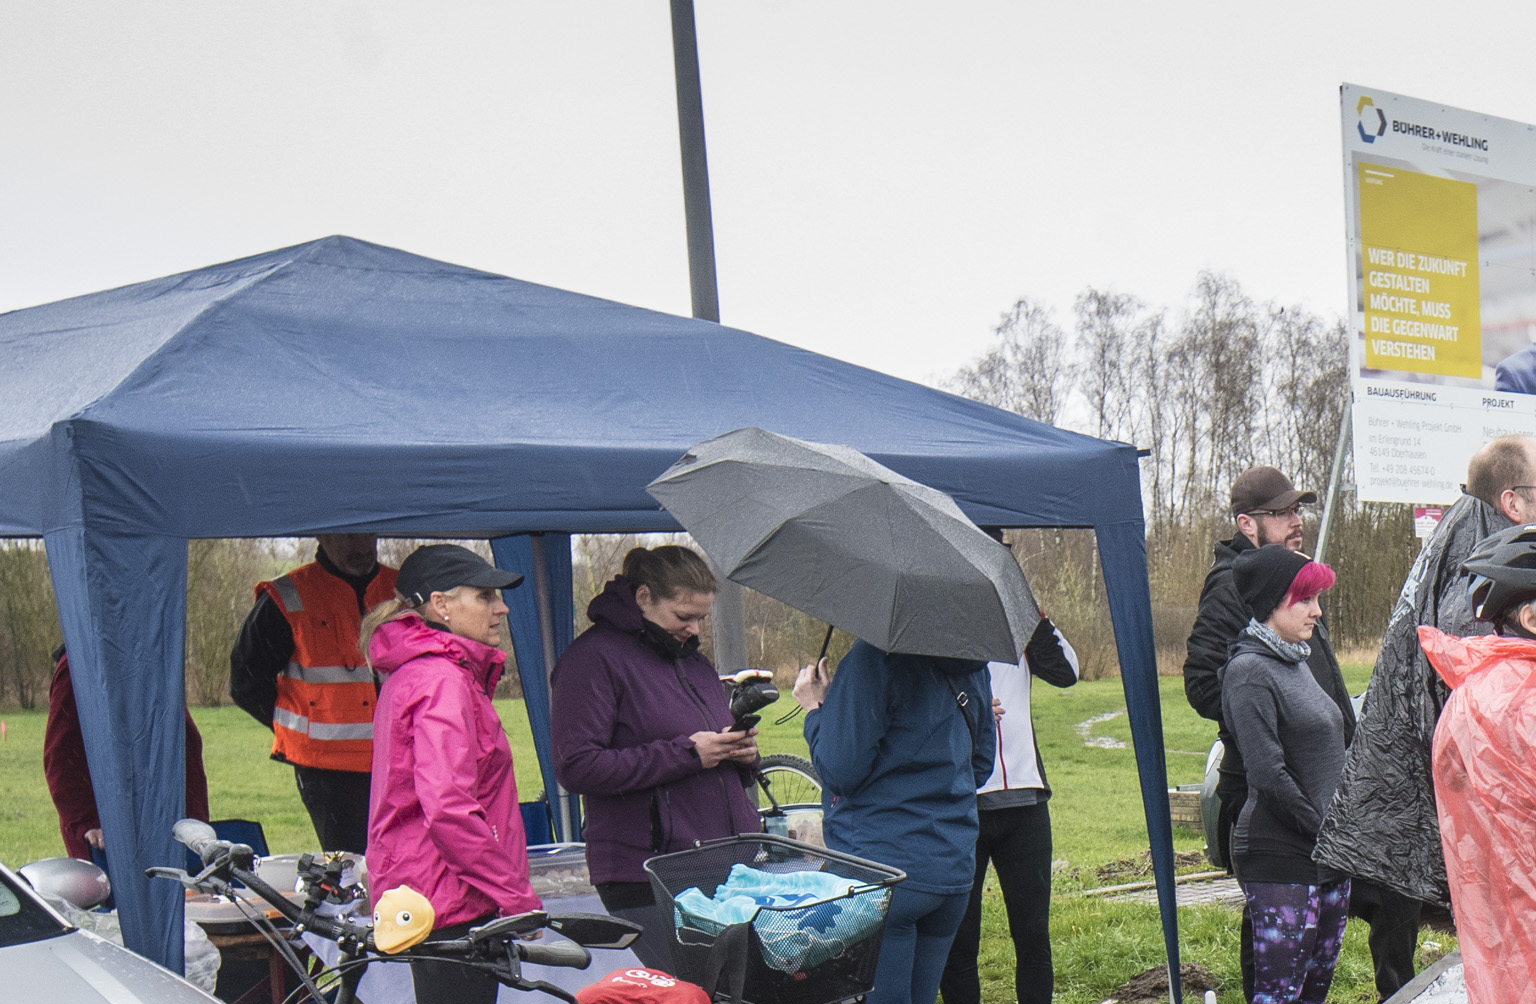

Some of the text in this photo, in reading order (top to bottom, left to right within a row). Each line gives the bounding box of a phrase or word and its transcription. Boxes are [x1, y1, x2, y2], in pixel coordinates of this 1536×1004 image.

[1392, 120, 1489, 151] BÜHRER+WEHLING
[1368, 247, 1467, 277] WER DIE ZUKUNFT
[1369, 270, 1430, 294] GESTALTEN
[1370, 292, 1451, 319] MÖCHTE, MUSS
[1371, 316, 1459, 342] DIE GEGENWART
[1371, 338, 1436, 361] VERSTEHEN
[1367, 386, 1437, 401] BAUAUSFÜHRUNG
[1482, 397, 1515, 408] PROJEKT
[1396, 419, 1420, 432] Wehling
[1421, 421, 1443, 433] Projekt
[1444, 423, 1462, 433] GmbH
[1413, 437, 1421, 446] 14
[1369, 447, 1427, 460] 46149 Oberhausen
[1382, 464, 1394, 474] +49
[1395, 464, 1408, 474] 208
